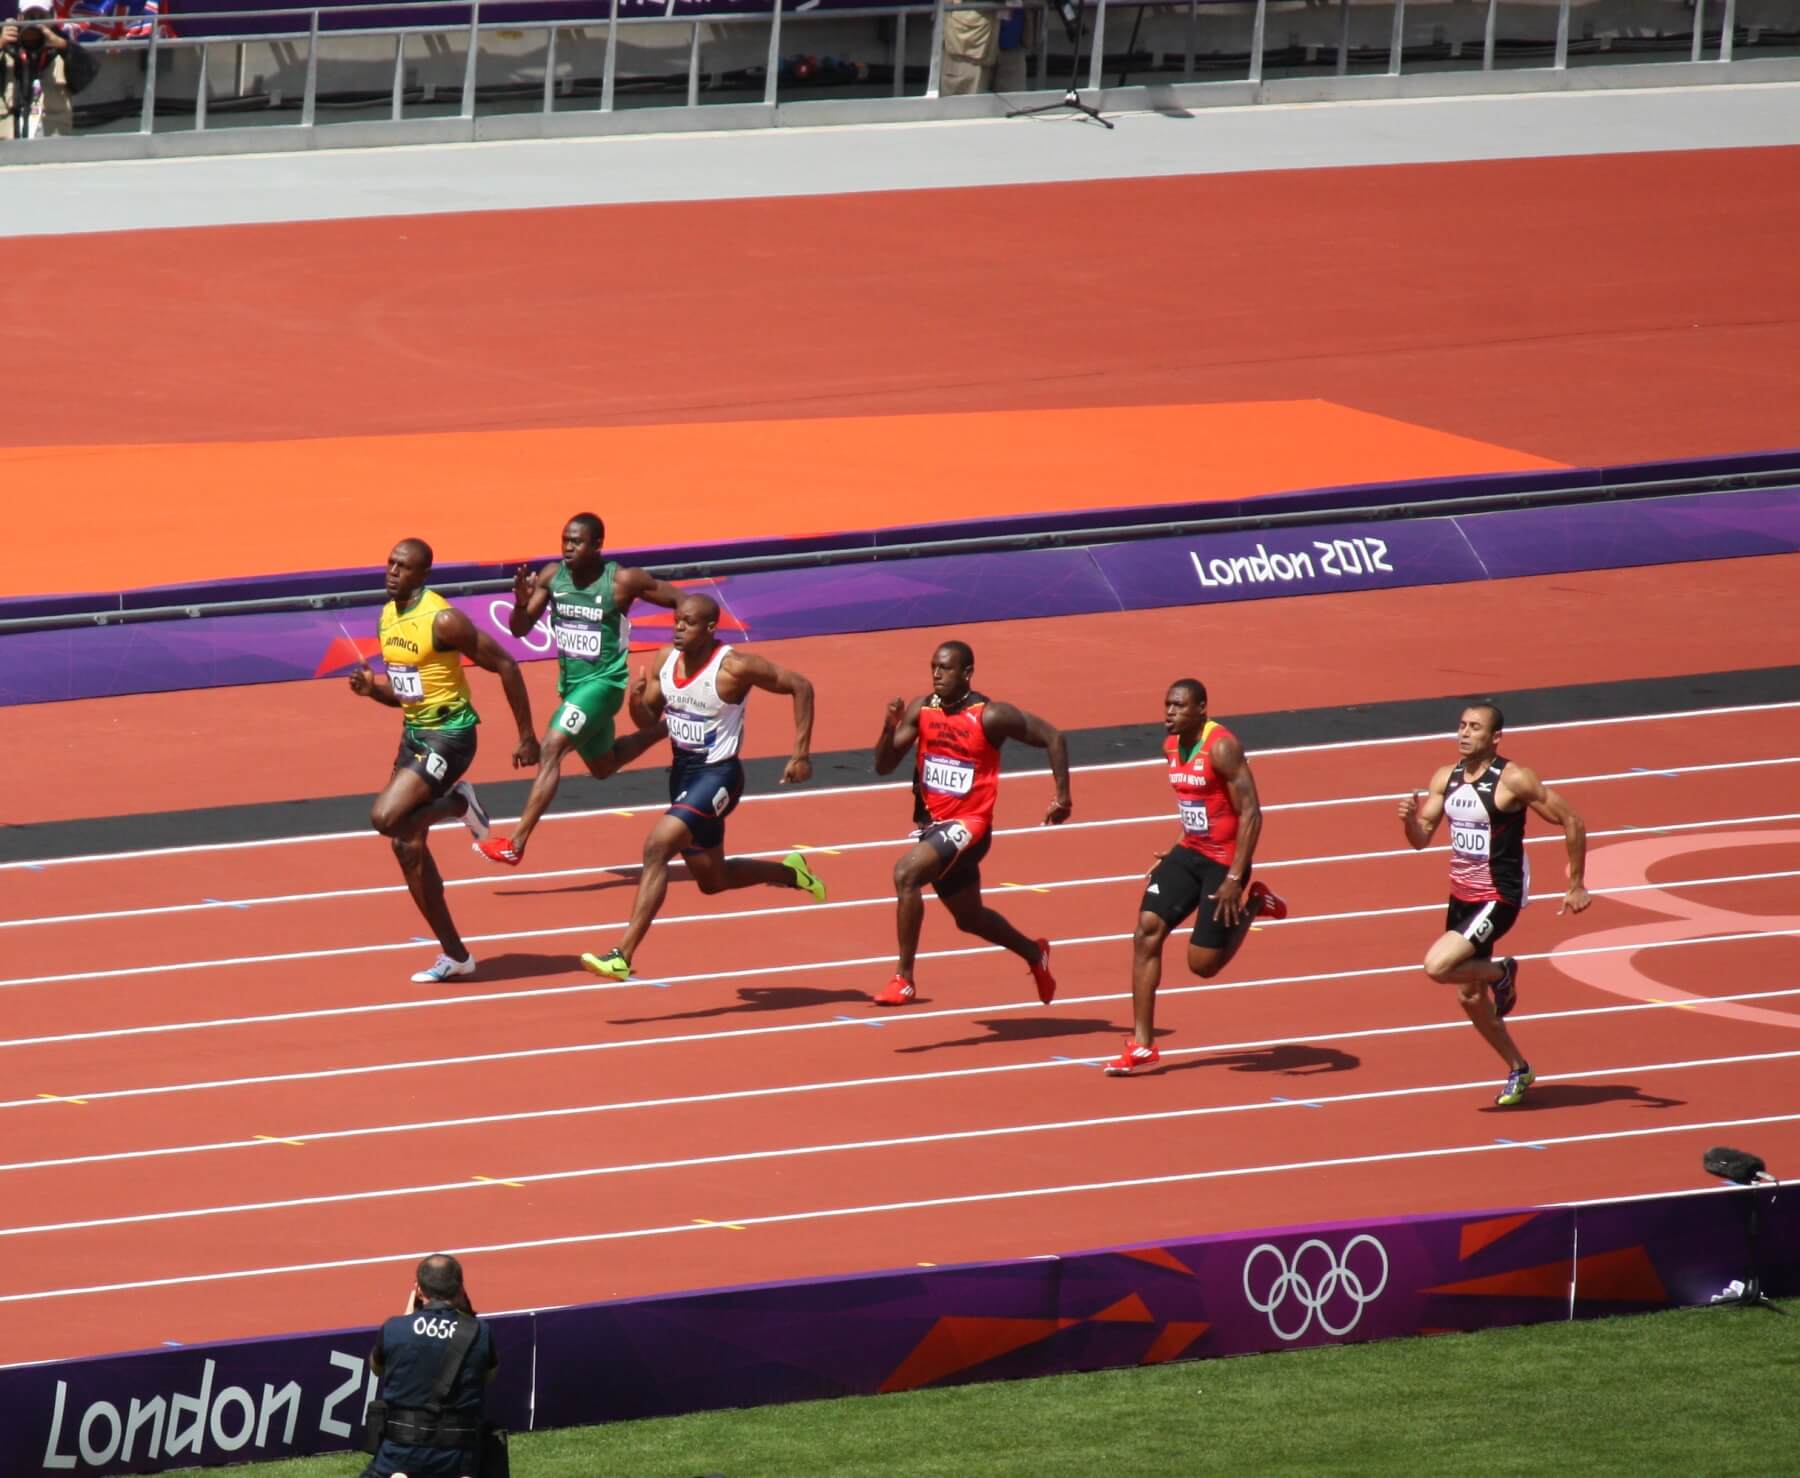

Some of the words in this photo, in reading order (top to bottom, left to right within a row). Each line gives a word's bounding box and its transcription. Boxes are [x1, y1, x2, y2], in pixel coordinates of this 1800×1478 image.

[1190, 543, 1315, 586] London
[1312, 537, 1394, 576] 2012
[566, 711, 580, 728] 8
[435, 758, 444, 773] 7
[926, 766, 968, 789] BAILEY
[953, 829, 967, 842] 5
[1476, 920, 1490, 937] 3
[42, 1358, 302, 1470] London
